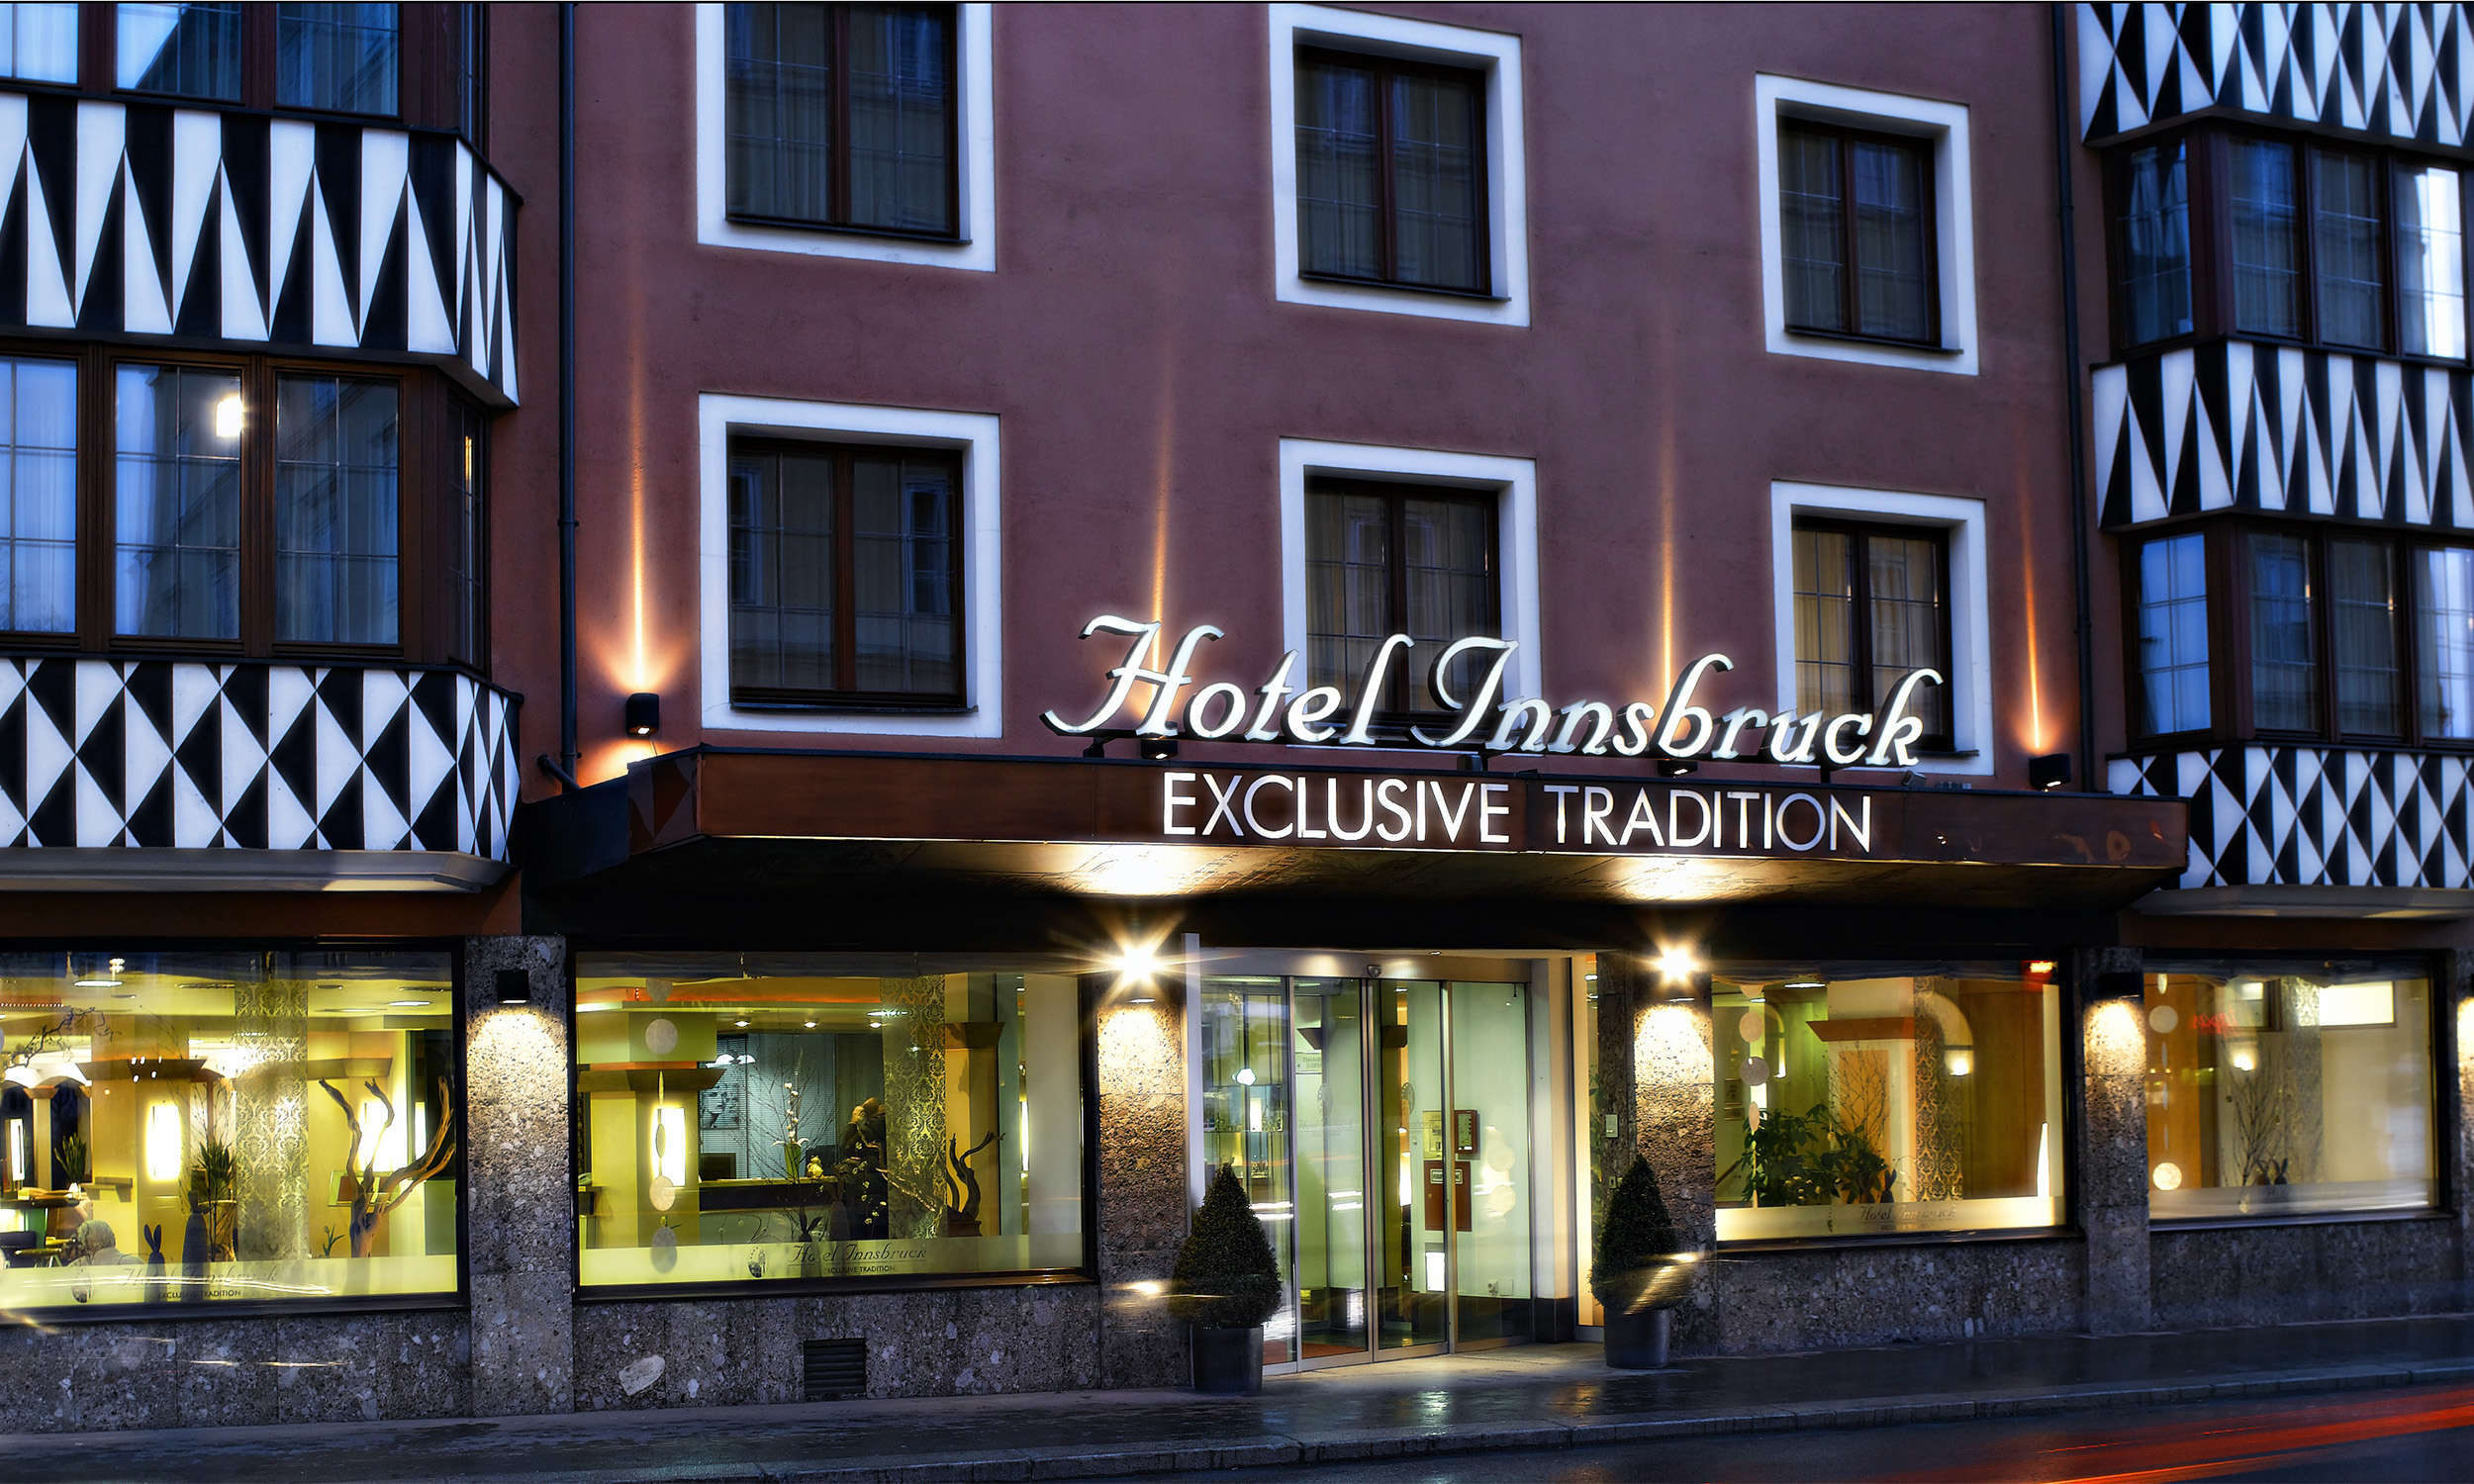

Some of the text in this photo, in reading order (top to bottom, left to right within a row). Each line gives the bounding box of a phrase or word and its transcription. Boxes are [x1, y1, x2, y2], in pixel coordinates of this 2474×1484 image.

[1043, 614, 1943, 767] Hotel Innsbruck
[1162, 771, 1873, 853] EXCLUSIVE TRADITION
[791, 1243, 839, 1262] Hoel
